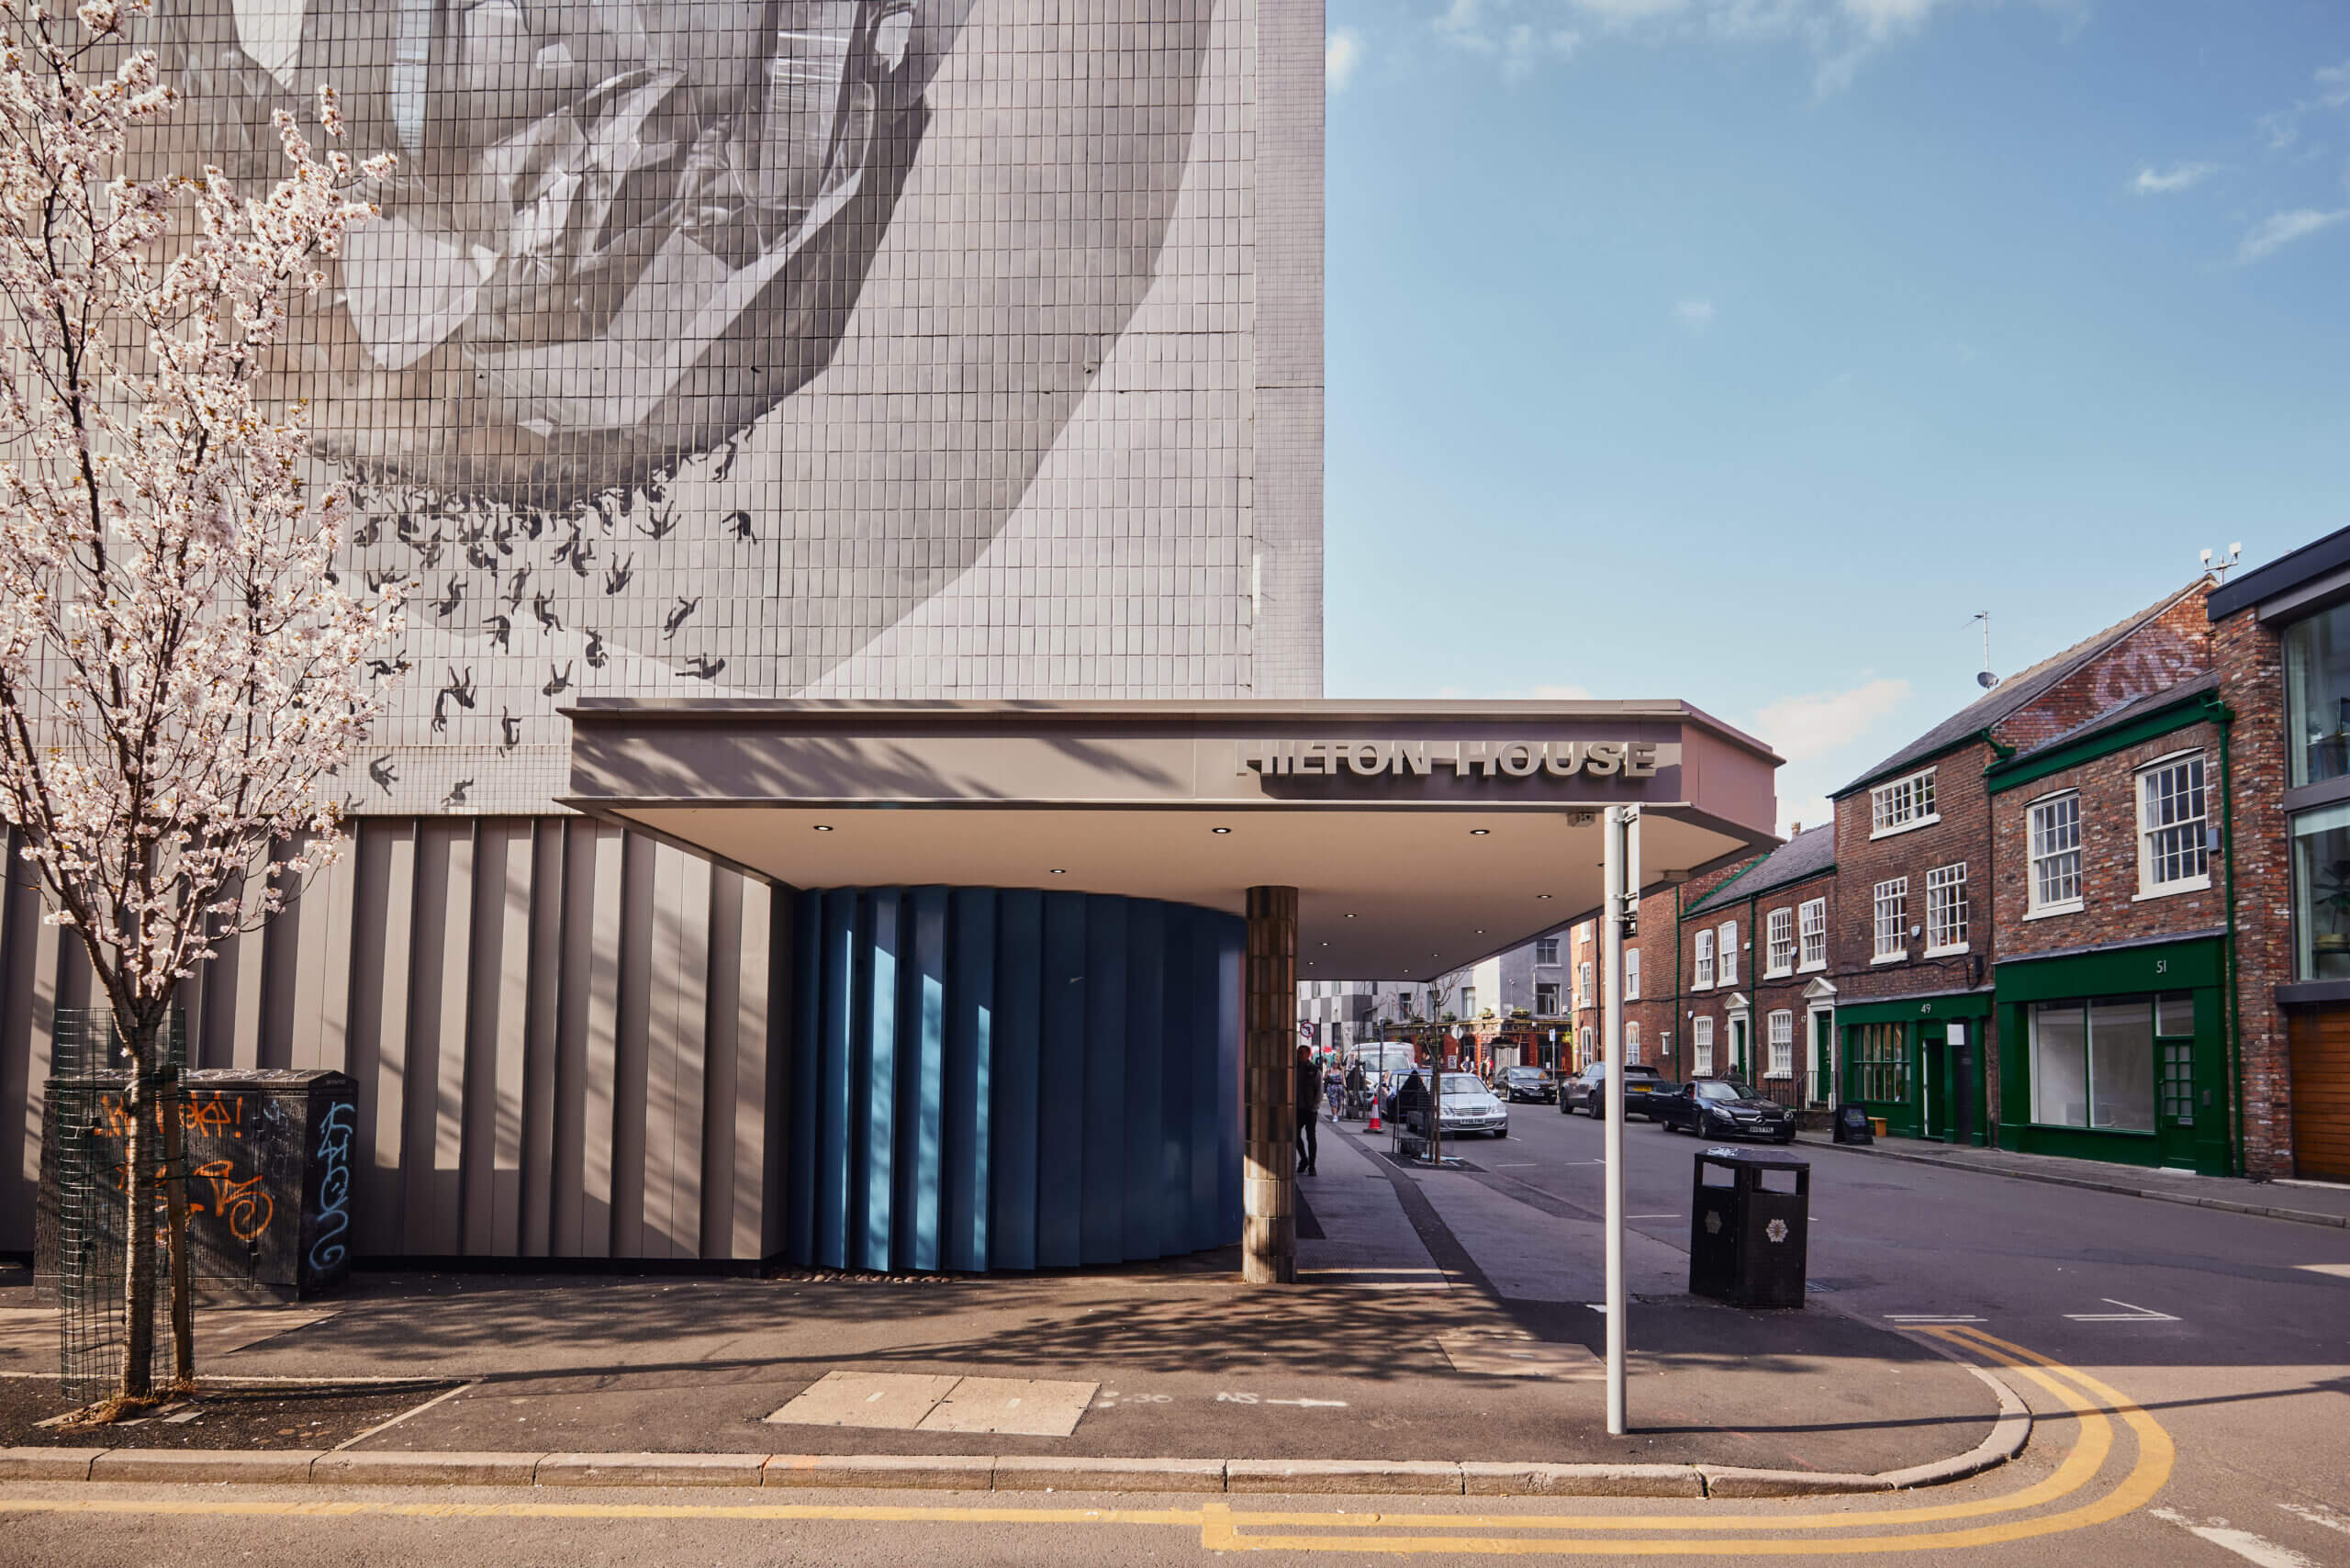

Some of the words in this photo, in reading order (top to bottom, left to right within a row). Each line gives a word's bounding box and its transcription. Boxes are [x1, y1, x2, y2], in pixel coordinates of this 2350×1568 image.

[1236, 740, 1432, 777] HILTON
[1456, 741, 1657, 778] HOUSE
[2156, 959, 2167, 974] 51
[1920, 1003, 1931, 1014] 49
